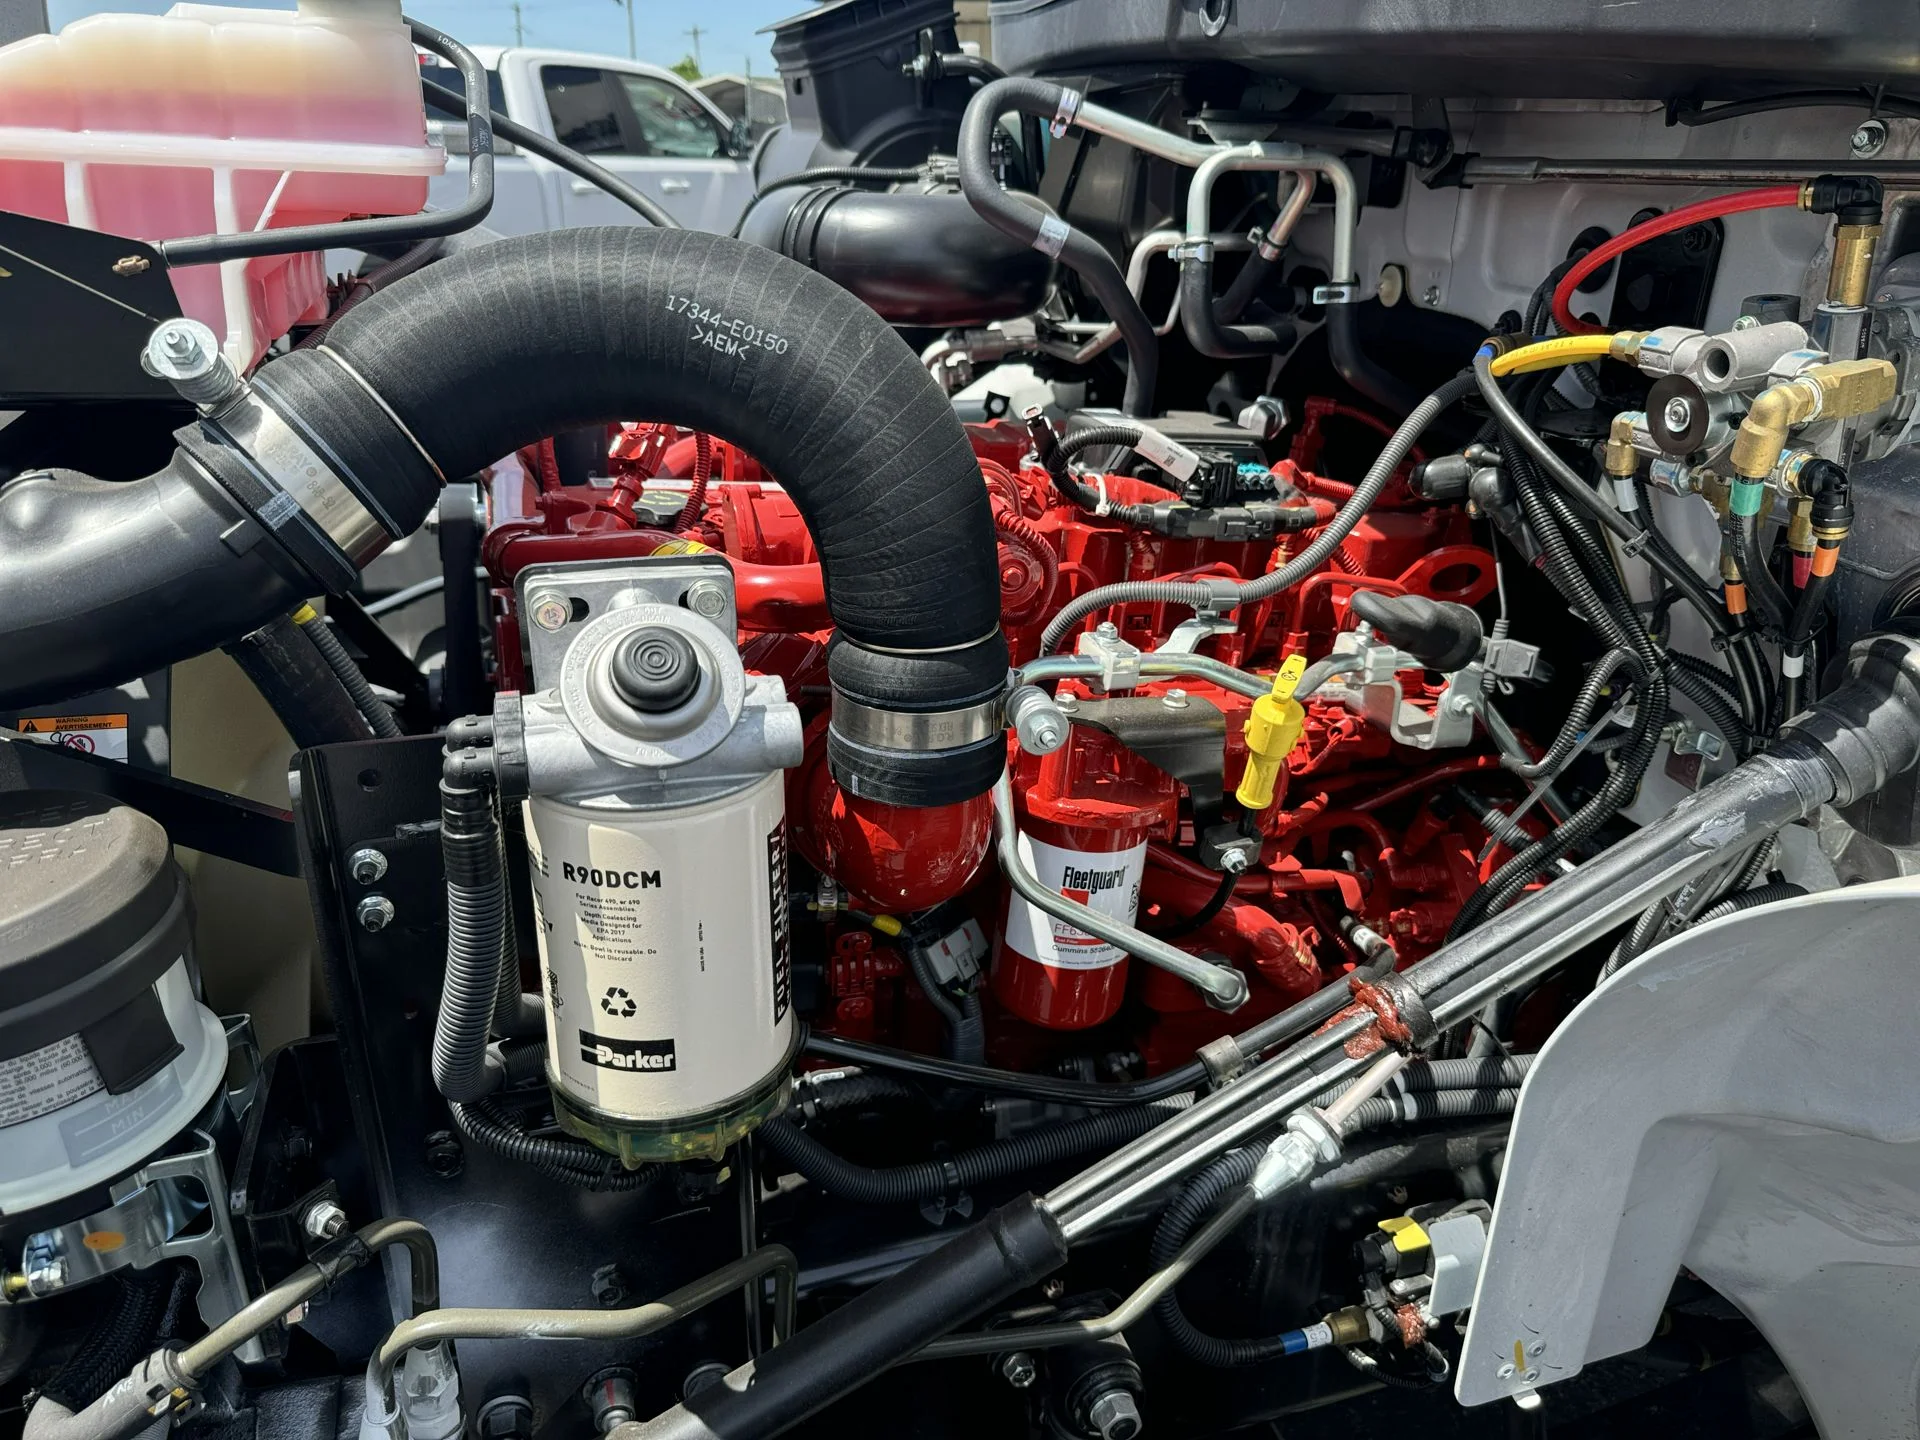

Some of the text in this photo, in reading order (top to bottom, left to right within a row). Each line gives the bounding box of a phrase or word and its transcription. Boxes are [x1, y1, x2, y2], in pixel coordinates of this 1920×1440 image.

[665, 295, 788, 355] 17344-E0150
[55, 716, 88, 724] WARNING
[55, 722, 112, 731] AVERTISSEMENT
[563, 862, 661, 889] R90DCM
[1062, 866, 1126, 894] Fleetguard
[575, 892, 585, 900] For
[579, 901, 597, 909] Series
[584, 911, 637, 922] Depth Coalescing
[580, 917, 598, 926] Media
[600, 921, 631, 929] Designed
[592, 934, 632, 943] Applications
[590, 944, 605, 953] Bowl
[1052, 944, 1087, 954] Cummins
[775, 952, 787, 1018] FUEL
[596, 1044, 674, 1069] Parker
